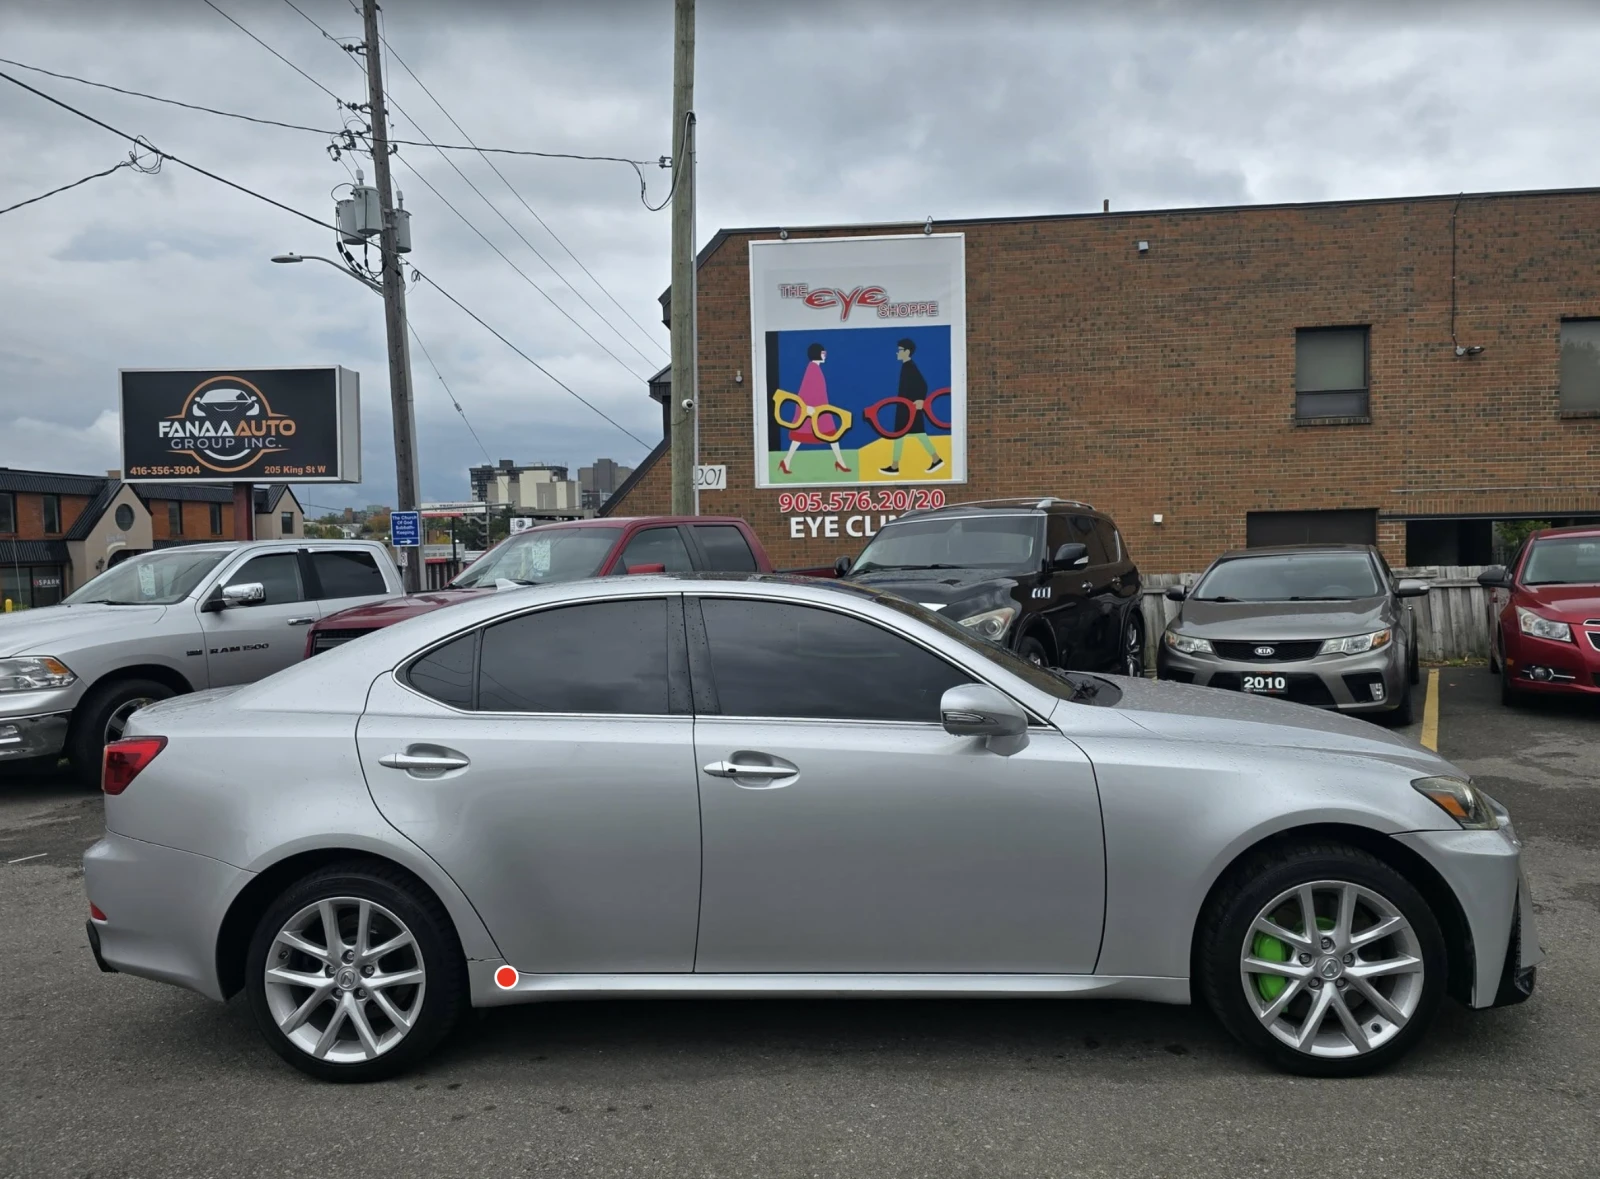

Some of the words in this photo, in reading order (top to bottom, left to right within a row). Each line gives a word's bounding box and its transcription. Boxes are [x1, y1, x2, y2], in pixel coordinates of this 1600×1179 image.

[779, 284, 808, 298] THE
[803, 286, 889, 321] EYE
[877, 301, 939, 318] SHOPPE
[171, 437, 235, 450] GROUP
[244, 437, 282, 448] INC.
[130, 465, 201, 475] 416-356-3904
[264, 465, 281, 474] 205
[283, 465, 303, 475] King
[305, 465, 315, 474] St
[317, 465, 326, 473] W
[692, 468, 722, 486] 201
[779, 489, 945, 513] 905.576.20/20
[790, 516, 839, 538] EYE
[38, 578, 60, 586] SPARK
[210, 646, 241, 655] RAM
[242, 643, 270, 651] 1500
[1243, 676, 1286, 689] 2010
